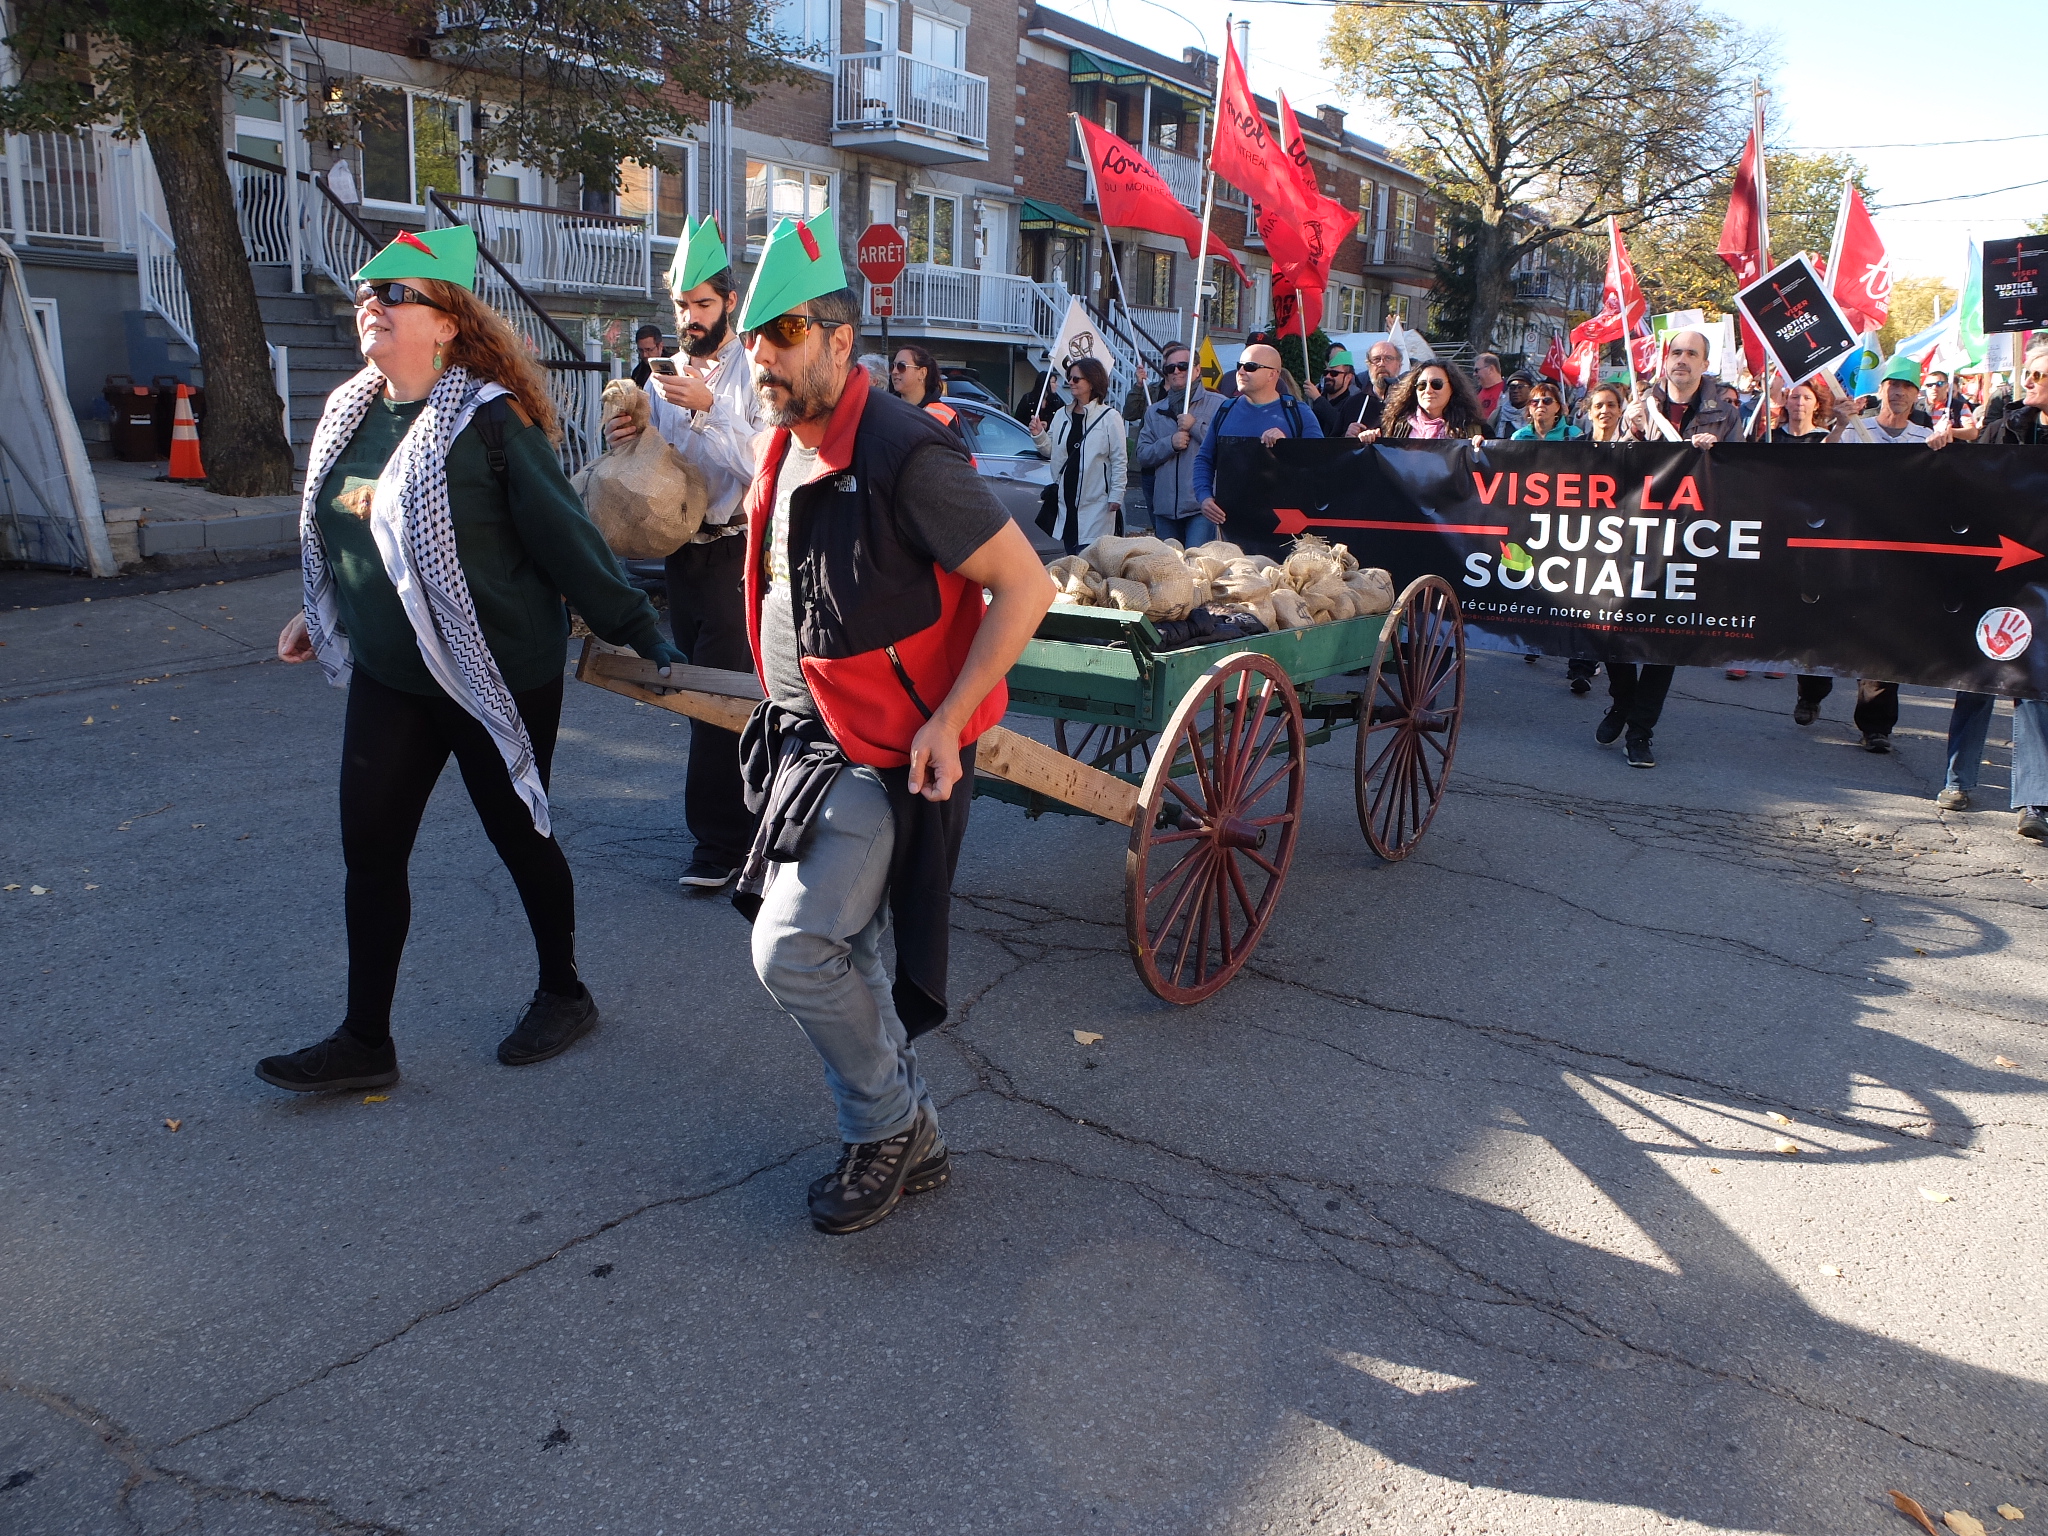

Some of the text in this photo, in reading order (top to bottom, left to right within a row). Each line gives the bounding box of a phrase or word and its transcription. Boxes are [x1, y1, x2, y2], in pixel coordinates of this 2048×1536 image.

[859, 242, 903, 263] ARRÊT
[2012, 269, 2038, 278] VISER
[1994, 281, 2033, 292] JUSTICE
[1998, 287, 2038, 297] SOCIALE
[1784, 299, 1810, 317] VISER
[1792, 310, 1805, 320] LA
[1775, 312, 1811, 338] JUSTICE
[1783, 315, 1820, 341] SOCIALE
[1472, 471, 1705, 511] VISER LA
[1526, 513, 1763, 560] JUSTICE
[1462, 551, 1698, 600] SOCIALE
[1461, 599, 1756, 629] récupérer notre trésor collectif
